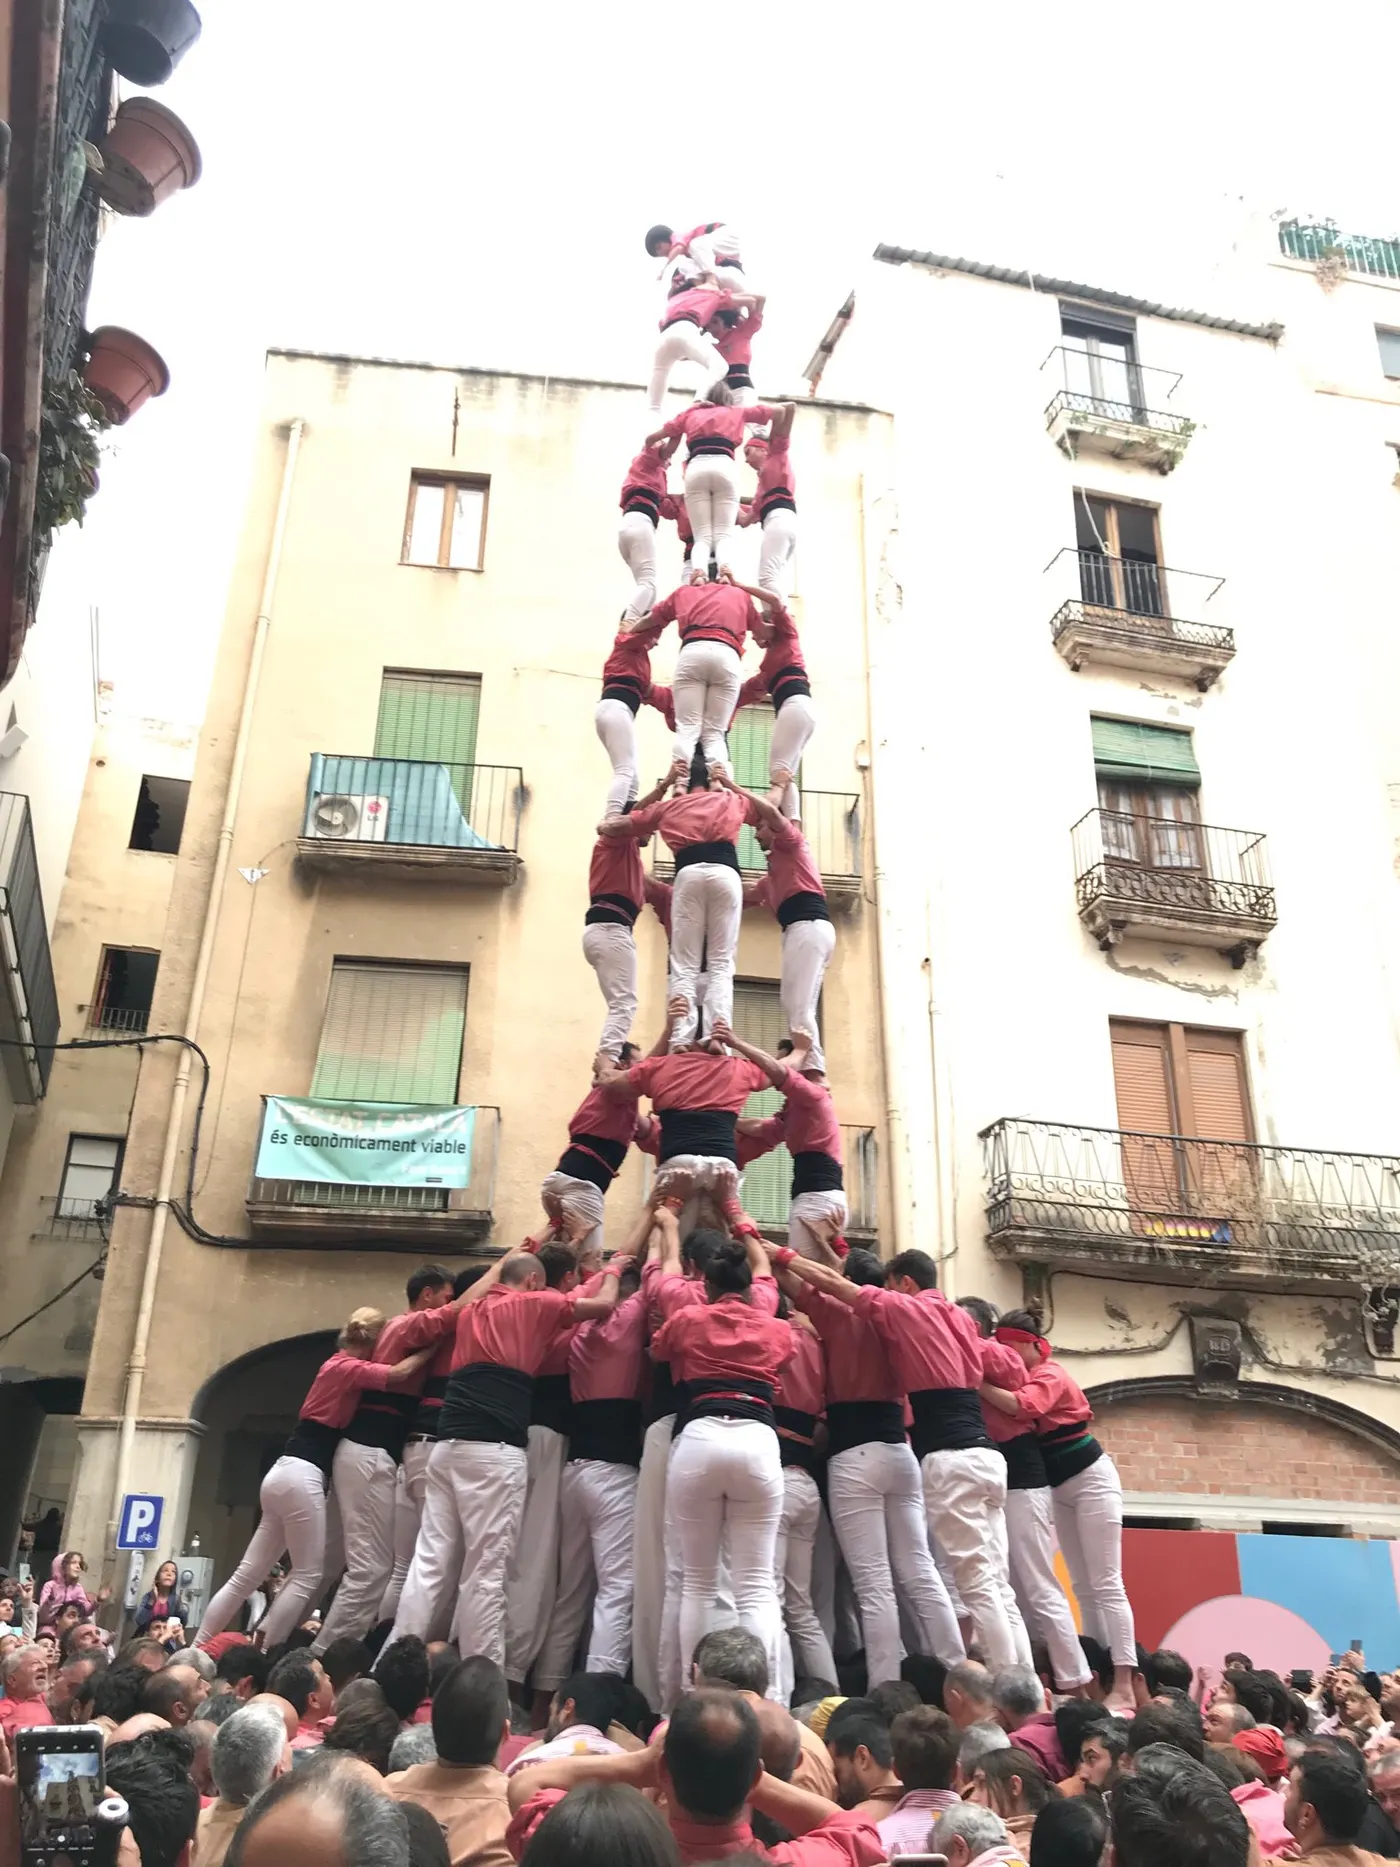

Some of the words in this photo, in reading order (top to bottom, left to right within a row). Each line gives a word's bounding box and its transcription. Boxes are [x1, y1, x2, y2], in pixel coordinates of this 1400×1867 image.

[270, 1129, 288, 1145] és
[293, 1132, 417, 1153] econòmicament
[421, 1138, 466, 1154] viable
[126, 1500, 155, 1543] P
